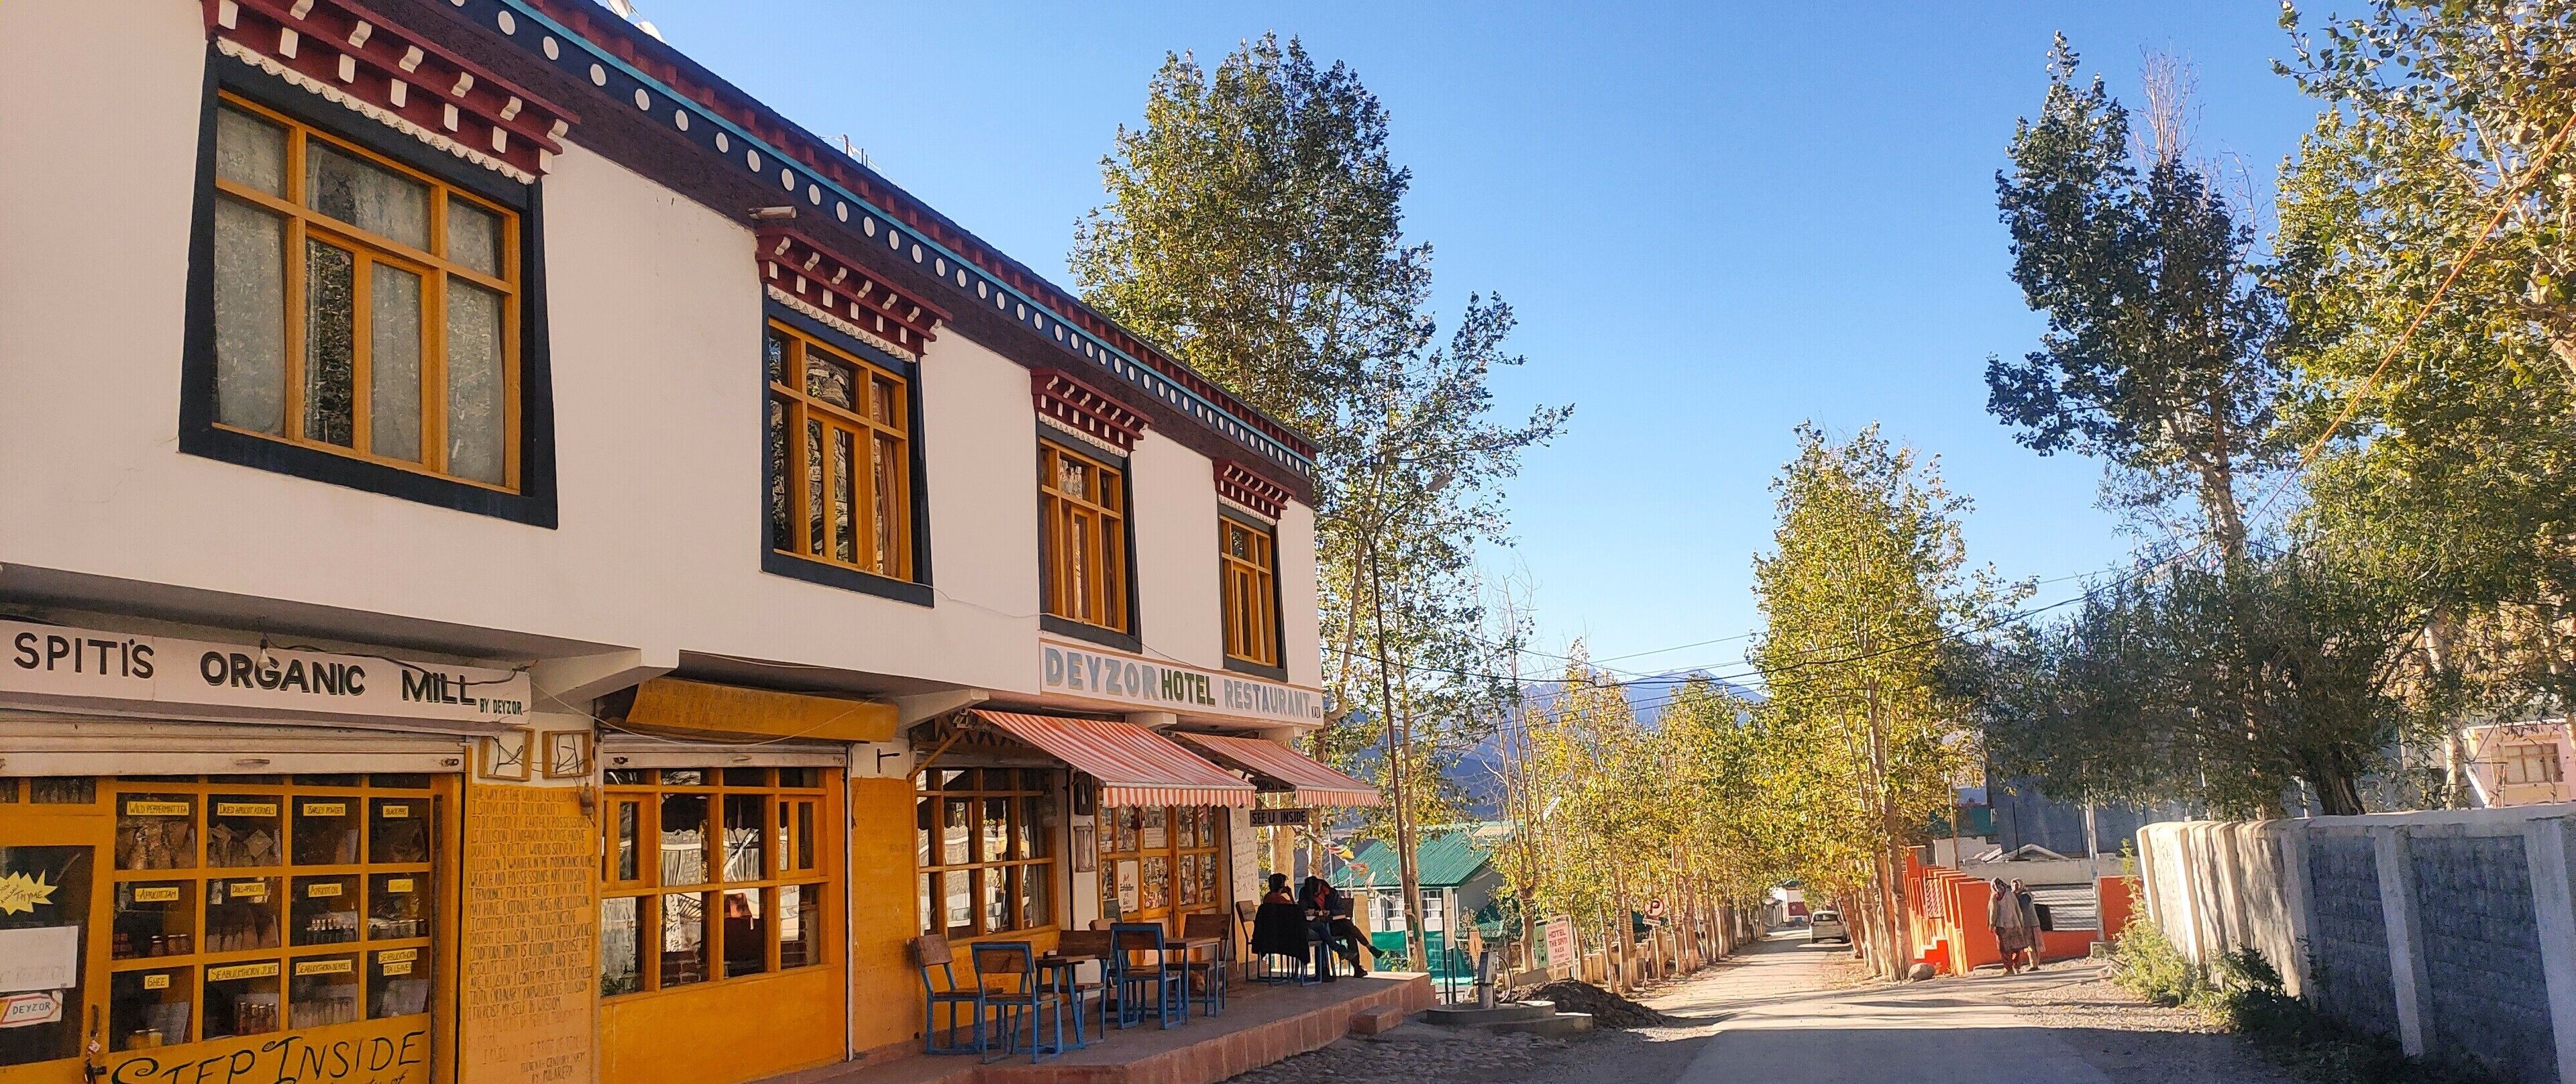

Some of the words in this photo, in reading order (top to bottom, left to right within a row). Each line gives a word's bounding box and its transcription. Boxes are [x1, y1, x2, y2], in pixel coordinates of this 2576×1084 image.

[14, 632, 154, 679] SPITI'S
[200, 651, 366, 697] ORGANIC
[402, 669, 477, 706] MILL
[1044, 647, 1159, 701] DEYZOR
[1161, 667, 1216, 708] HOTEL
[1224, 679, 1310, 718] RESTAURANT
[480, 698, 489, 714] BY
[493, 698, 523, 716] DEYZOR
[1252, 812, 1266, 824] SEE
[1269, 812, 1275, 824] U
[1280, 810, 1307, 823] INSIDE
[13, 889, 43, 904] THYME
[1548, 929, 1566, 939] HOTEL
[1549, 939, 1557, 947] THE
[1557, 938, 1568, 946] SPITI
[148, 976, 165, 987] GHEE
[12, 1001, 51, 1015] DEYZOR
[262, 1030, 426, 1079] INSIDE
